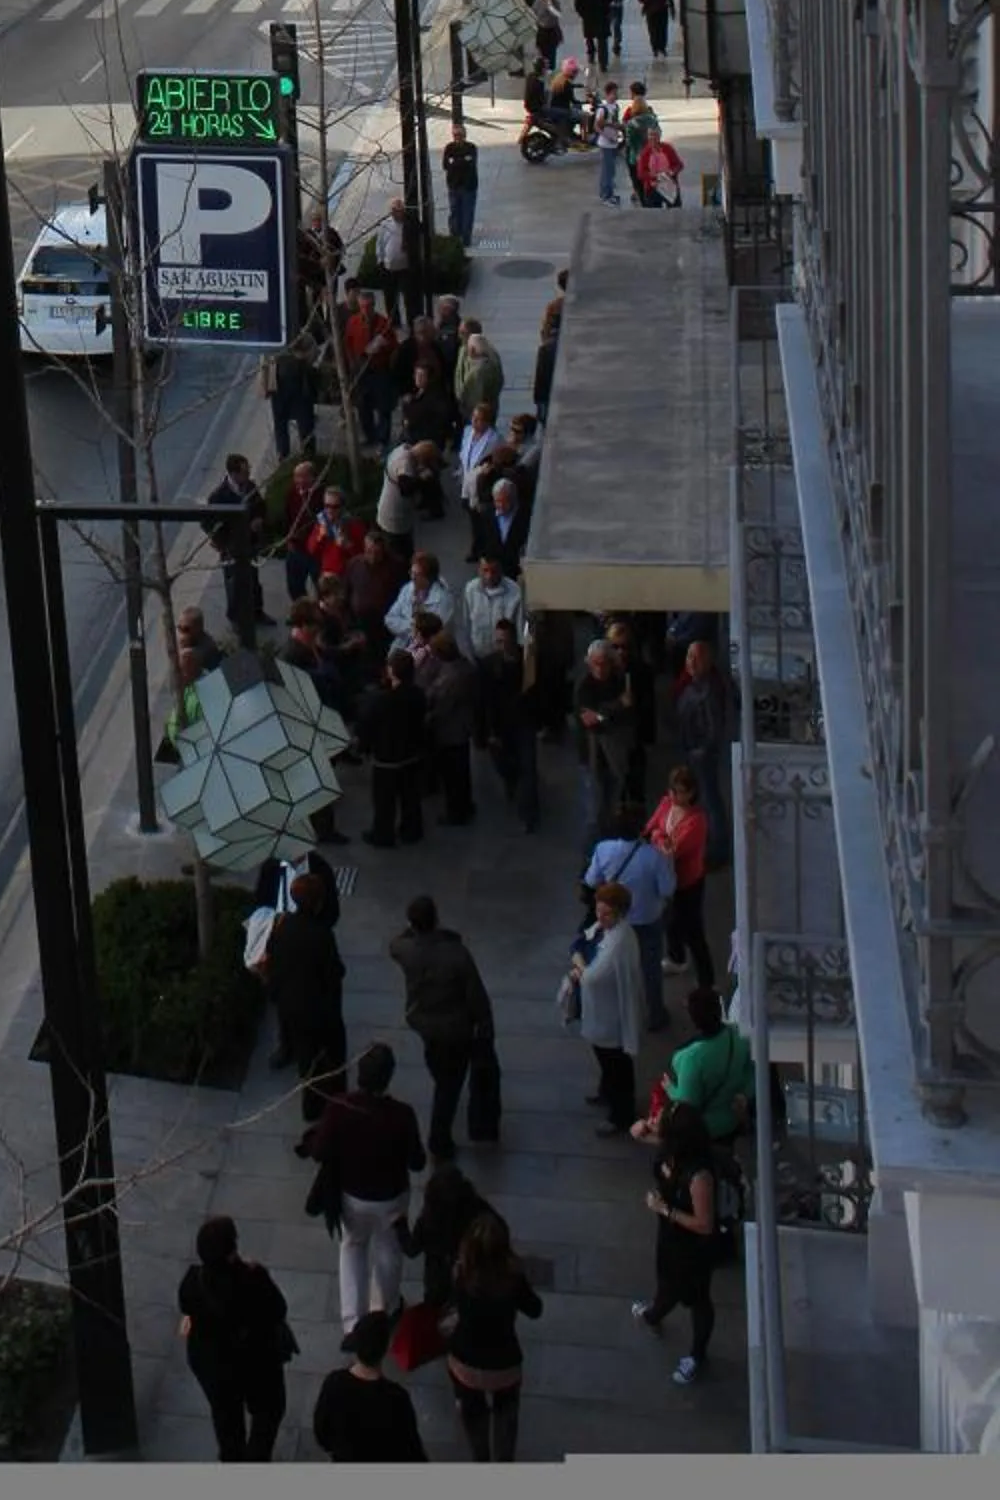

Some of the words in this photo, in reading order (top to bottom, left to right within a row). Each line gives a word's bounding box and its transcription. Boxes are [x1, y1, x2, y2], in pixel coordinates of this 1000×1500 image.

[147, 78, 271, 111] ABIERTO
[150, 111, 172, 135] 24
[181, 113, 244, 137] HORAS
[156, 163, 273, 265] P
[161, 269, 193, 286] SAN
[183, 311, 241, 329] LIBRE
